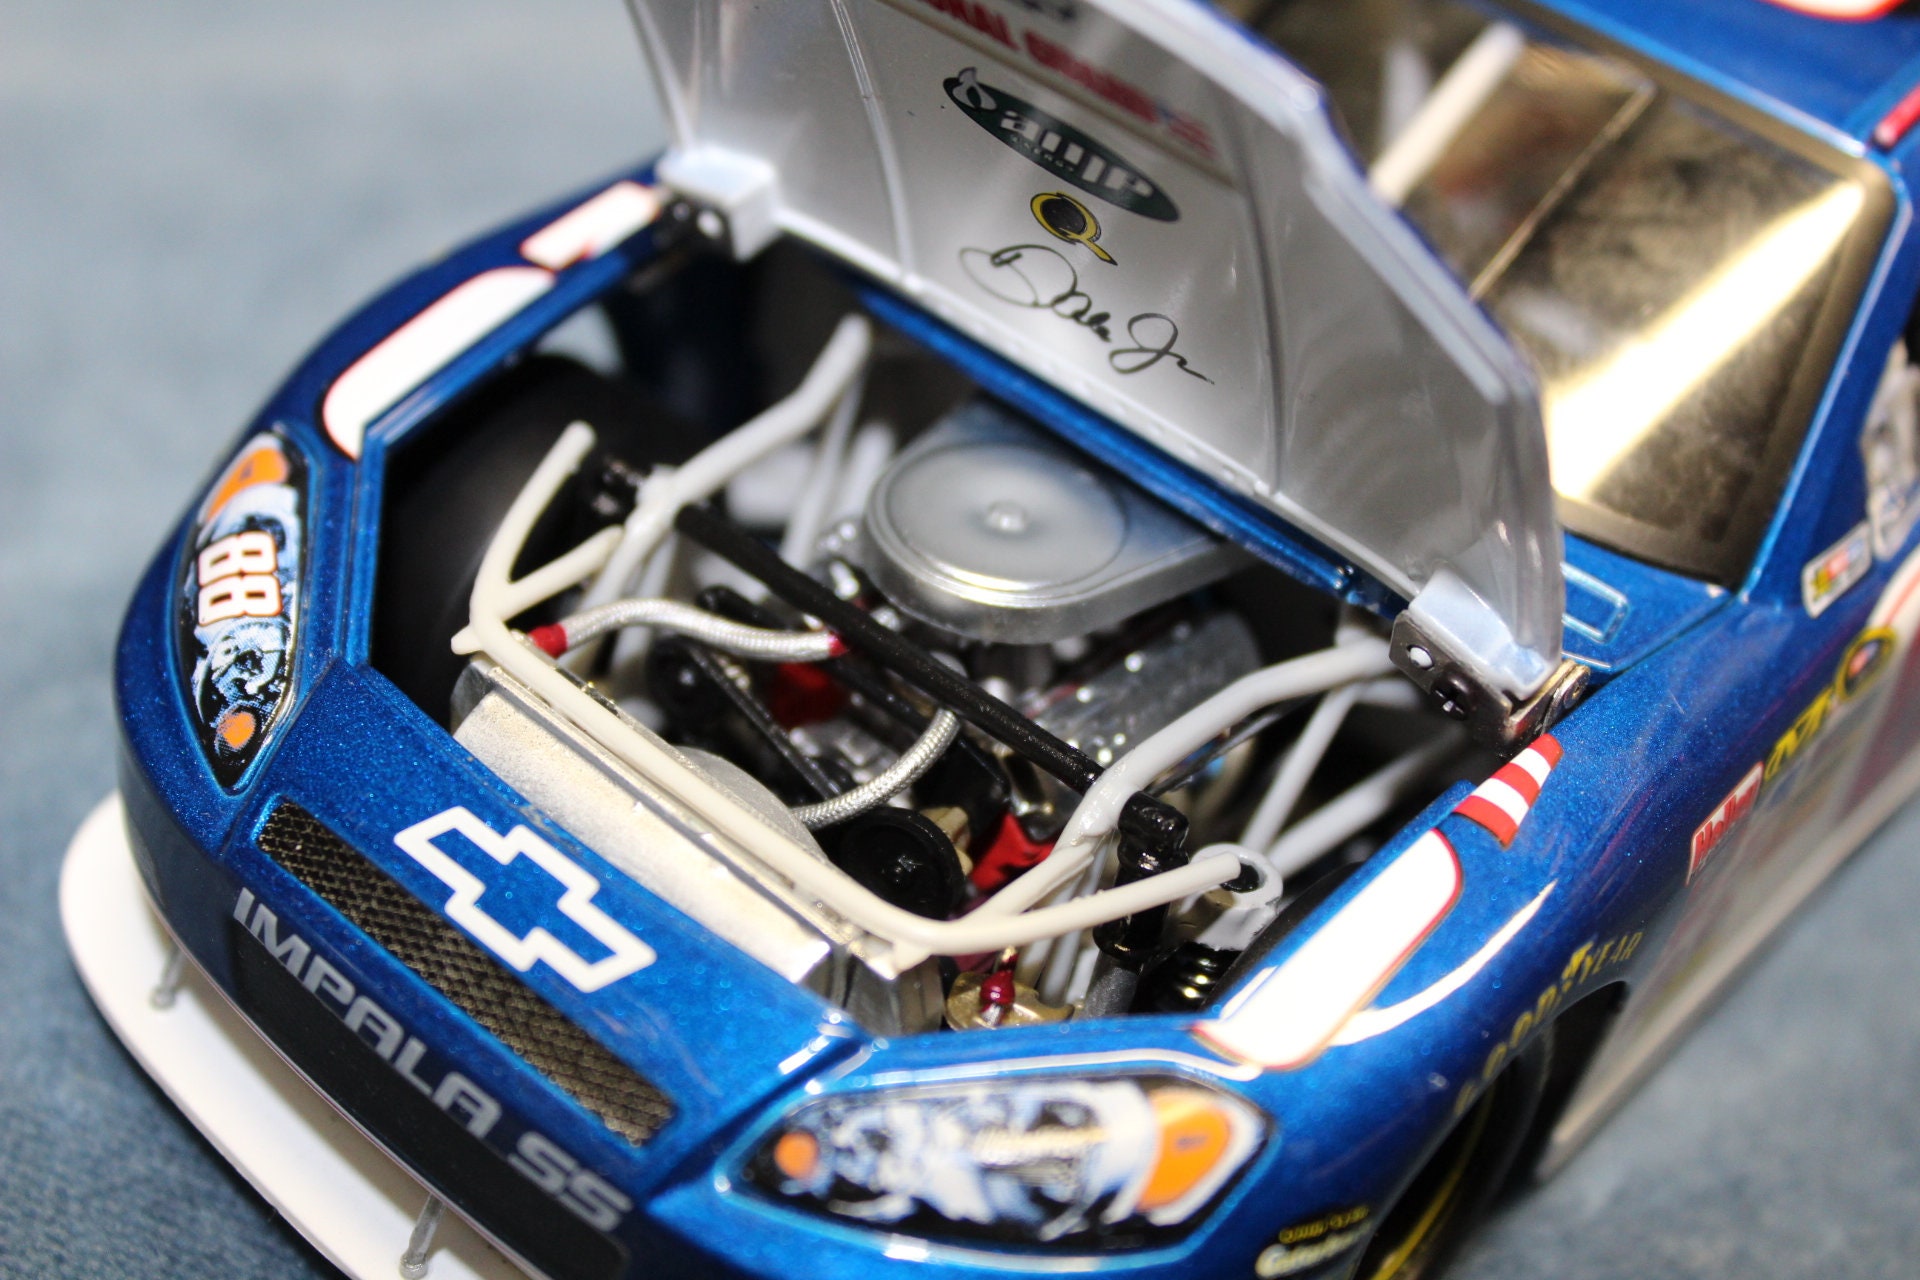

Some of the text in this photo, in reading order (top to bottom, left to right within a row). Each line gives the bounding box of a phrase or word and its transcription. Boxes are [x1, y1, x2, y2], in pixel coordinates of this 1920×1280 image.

[198, 529, 282, 627] 88
[233, 886, 633, 1232] IMPALA SS
